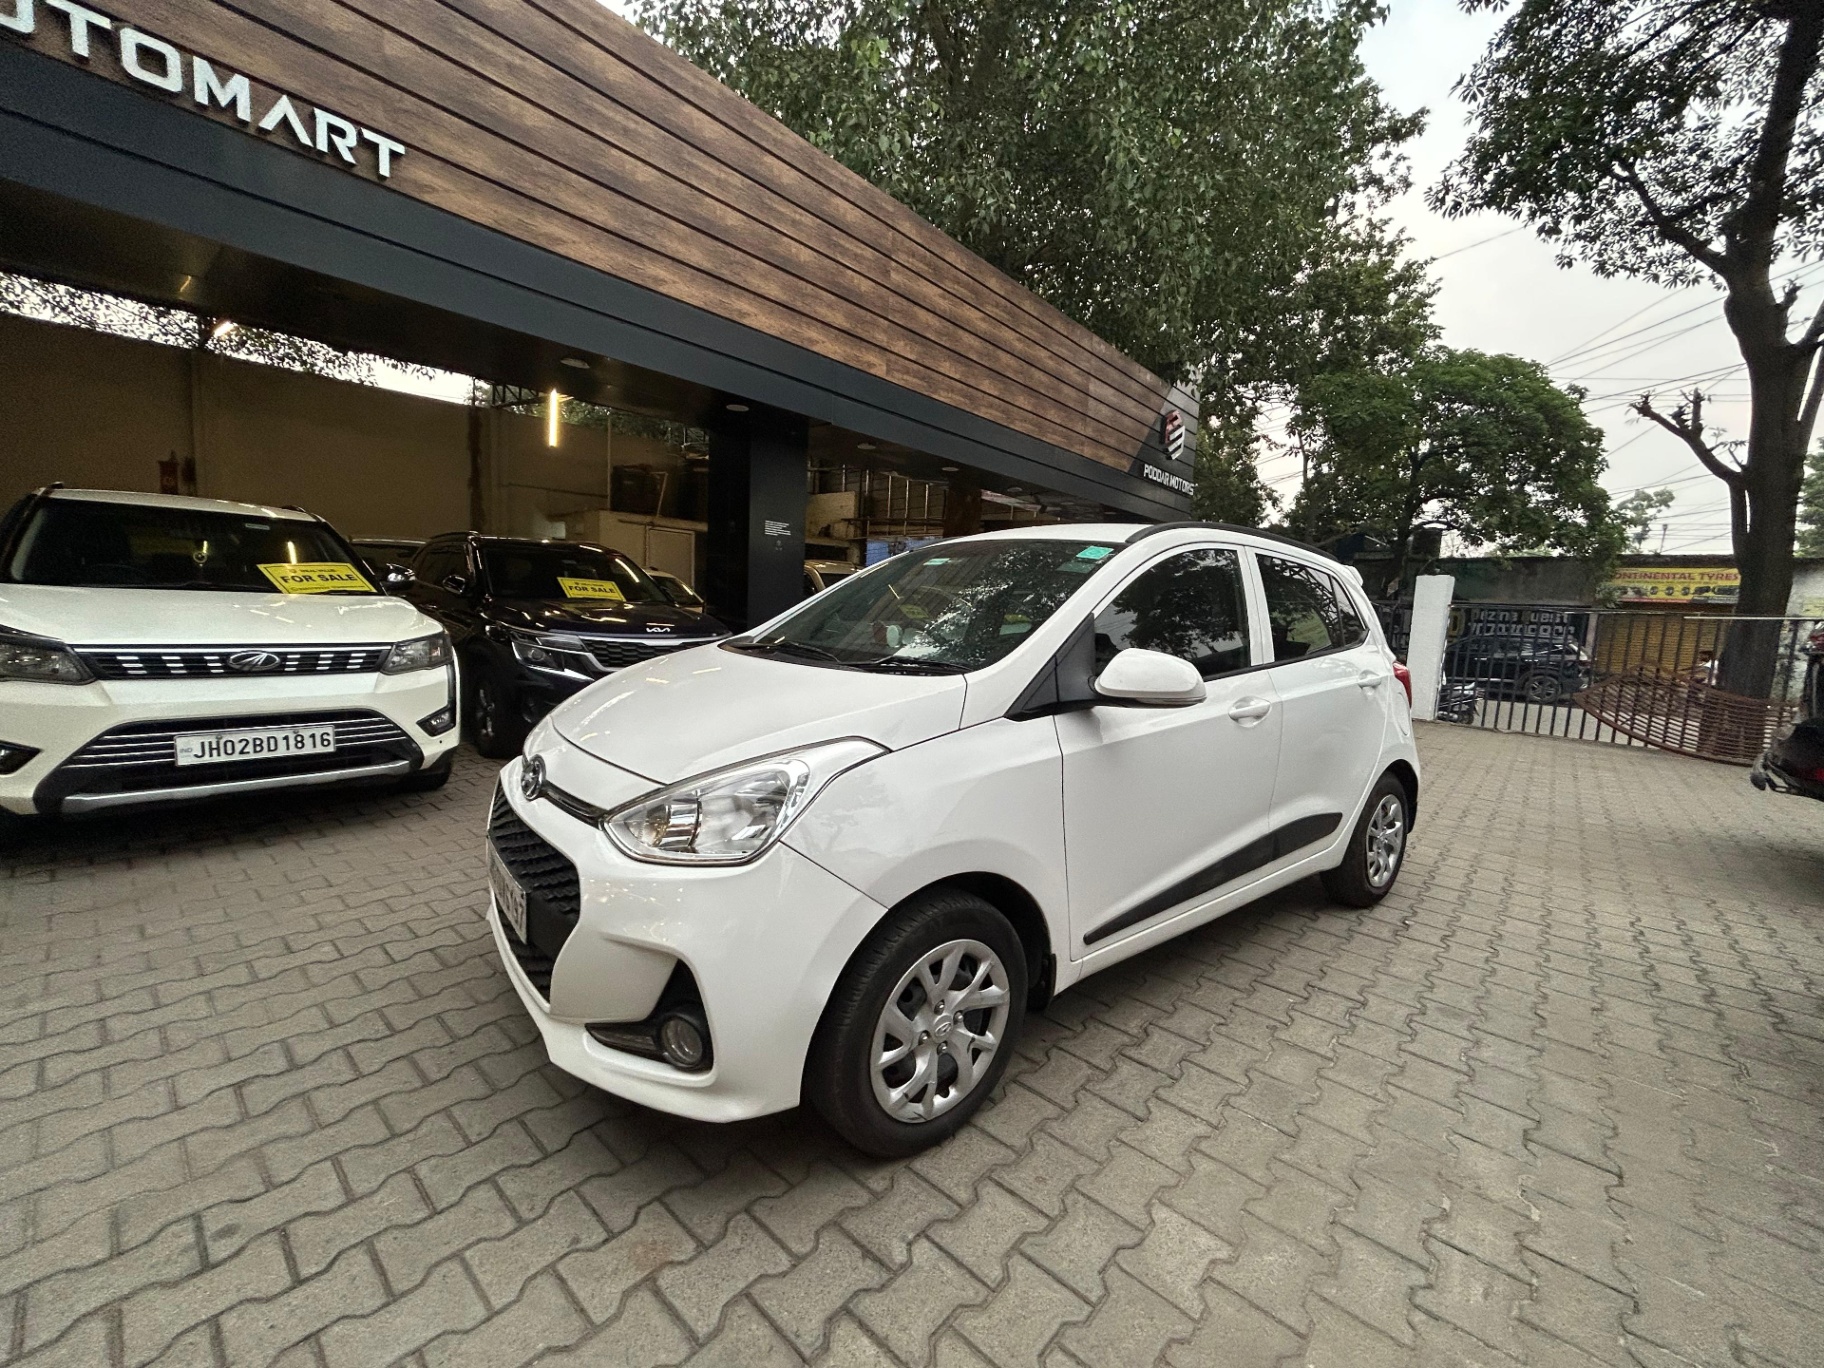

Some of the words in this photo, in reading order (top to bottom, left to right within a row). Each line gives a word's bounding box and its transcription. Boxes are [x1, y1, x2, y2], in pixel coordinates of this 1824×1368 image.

[1143, 463, 1169, 487] PODDAR
[1170, 475, 1194, 496] MOTORS
[280, 574, 316, 584] FOR
[317, 573, 358, 583] SALE
[1614, 571, 1695, 581] ONTINENTAL
[1699, 571, 1739, 581] TYRES
[590, 586, 616, 594] SALE
[193, 731, 332, 759] JH02BD1816
